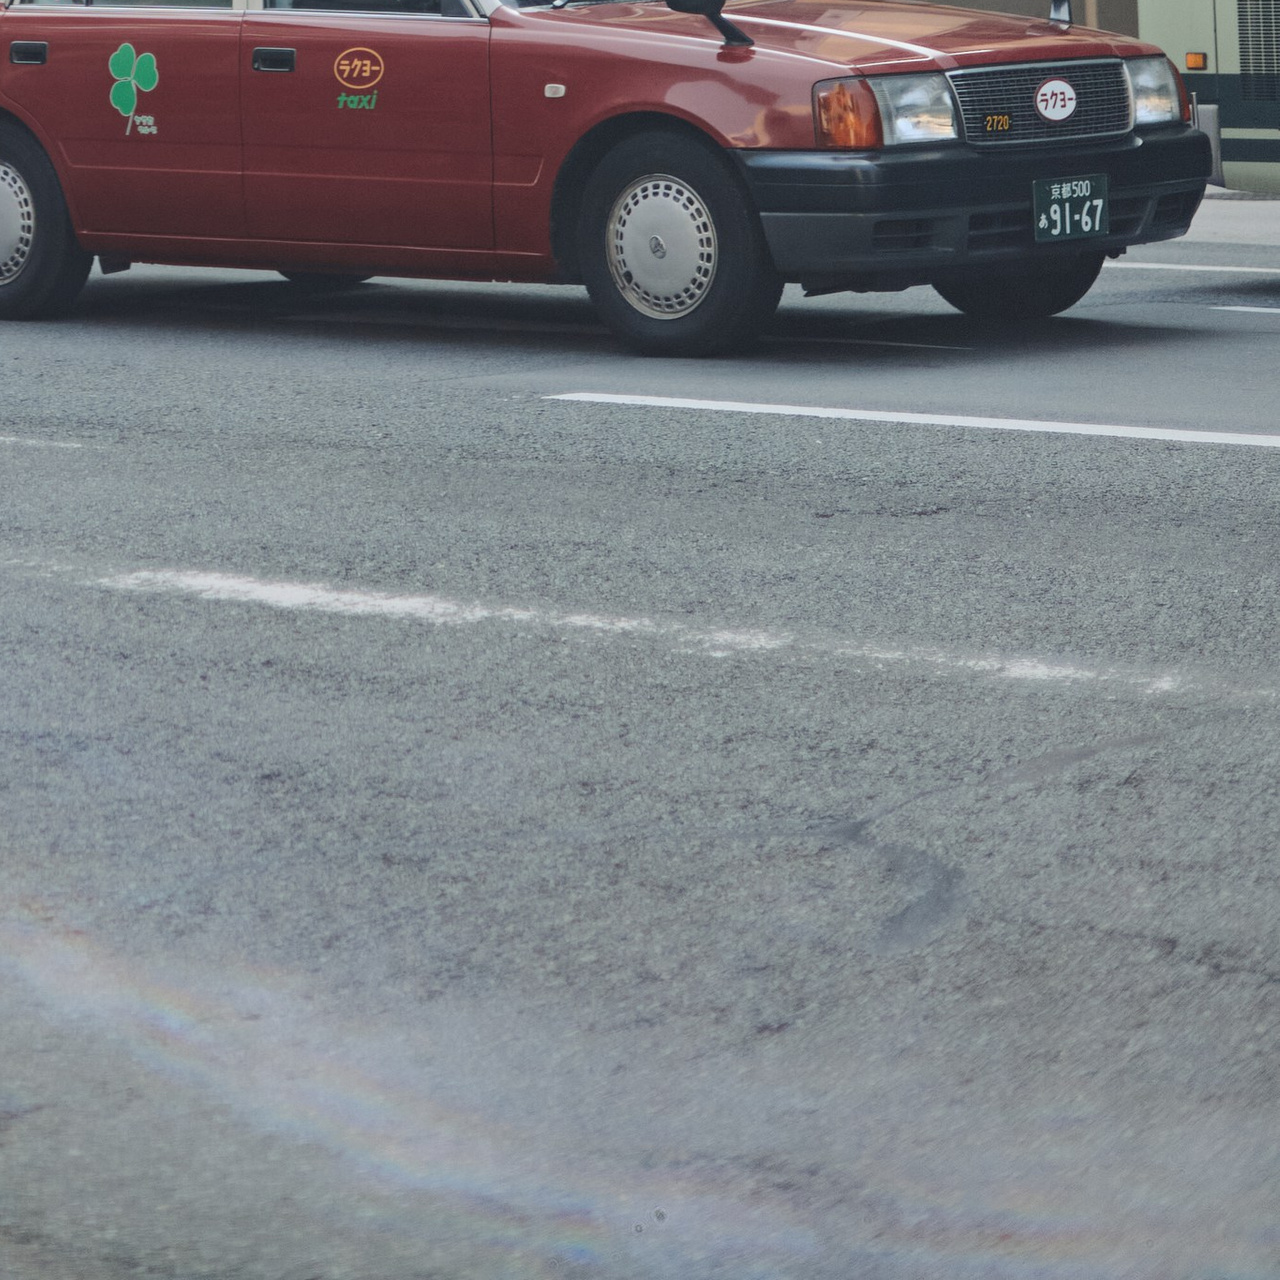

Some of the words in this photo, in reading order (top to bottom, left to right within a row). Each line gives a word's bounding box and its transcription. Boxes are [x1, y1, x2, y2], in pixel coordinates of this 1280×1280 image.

[339, 58, 380, 79] ラクヨー
[336, 89, 379, 109] taxi
[1039, 90, 1075, 111] ラクヨー
[985, 115, 1010, 131] 2720
[1038, 212, 1049, 229] あ
[1049, 198, 1104, 236] 91-67
